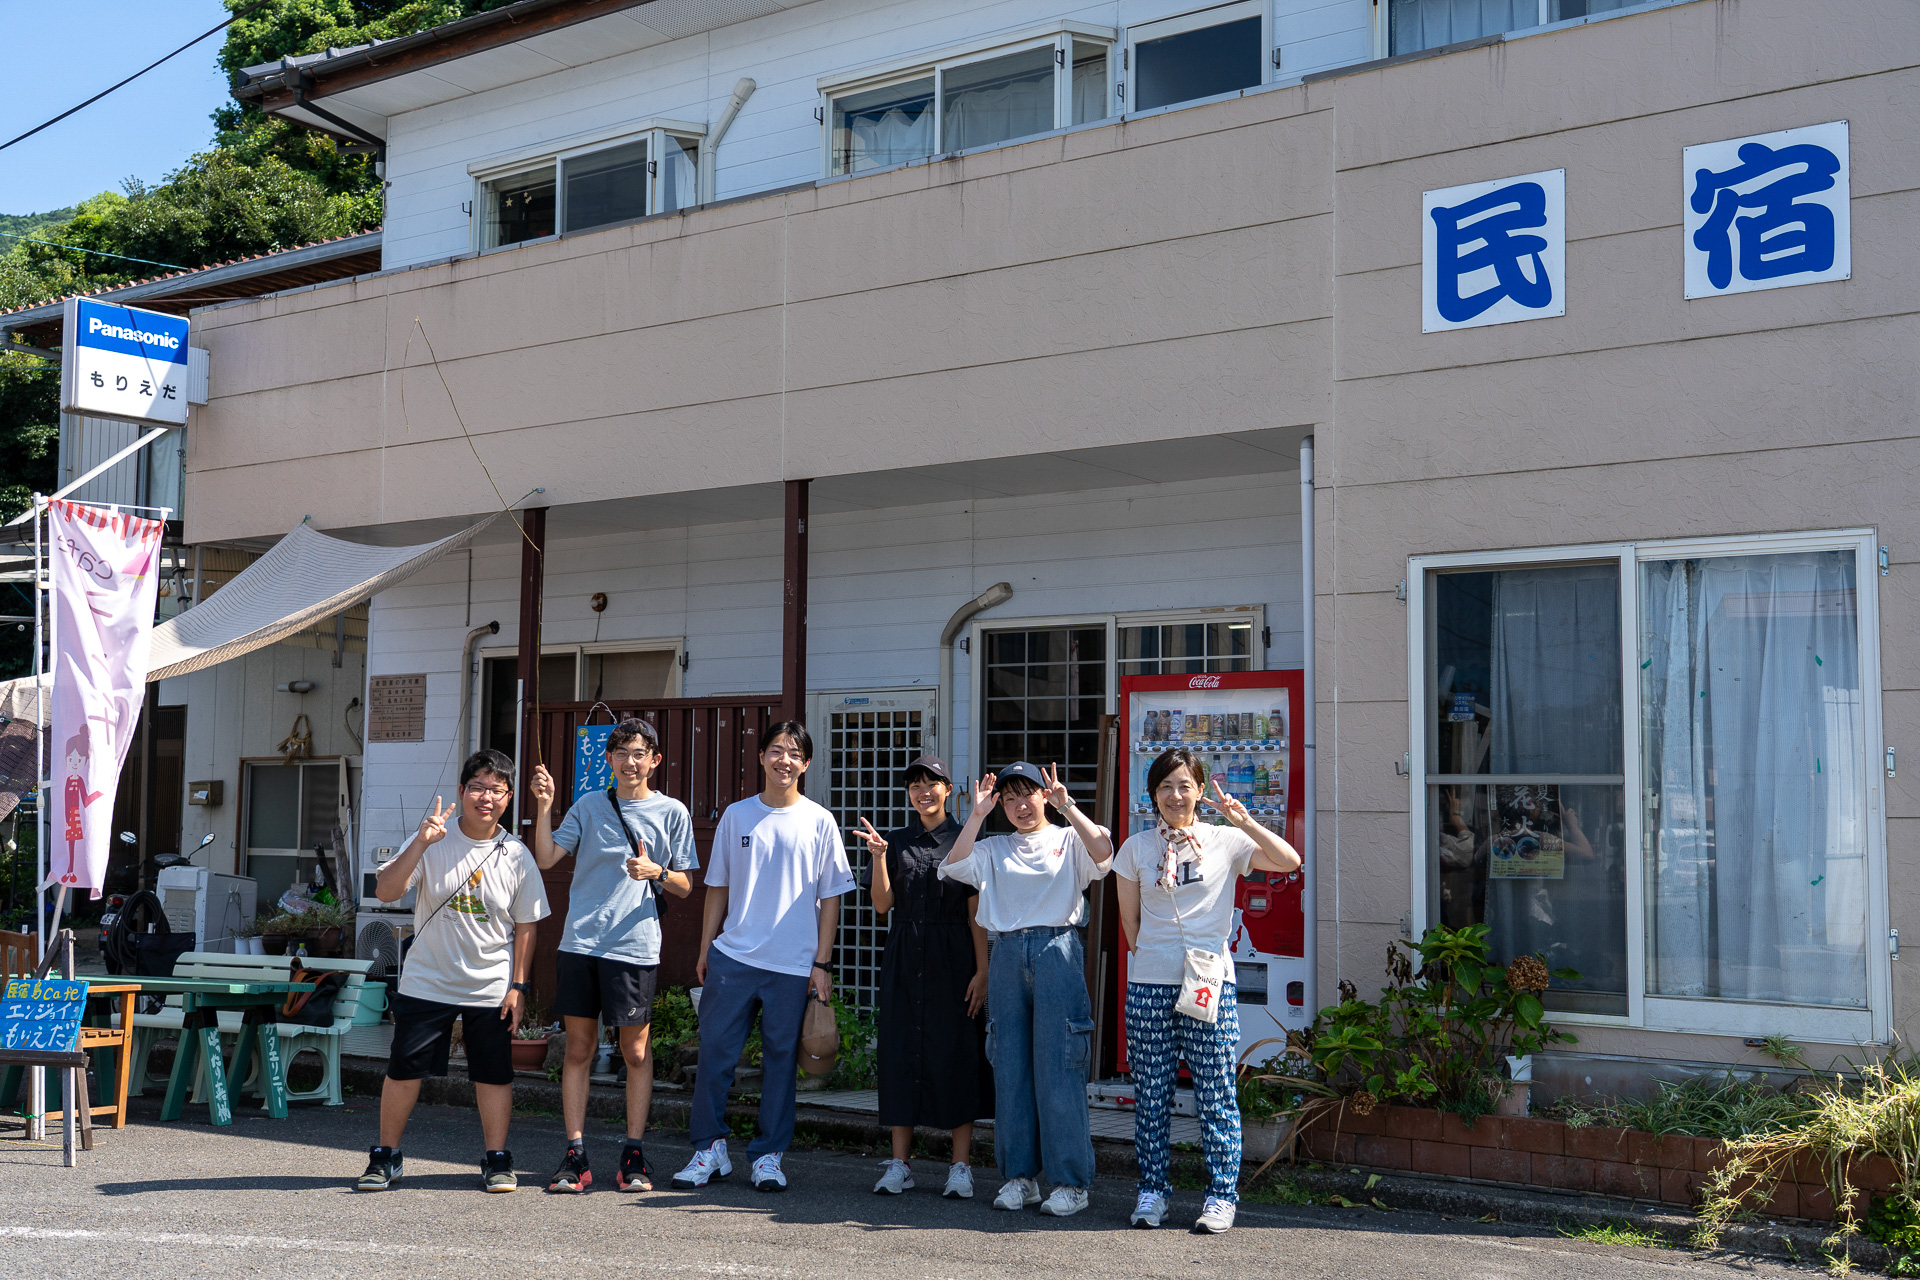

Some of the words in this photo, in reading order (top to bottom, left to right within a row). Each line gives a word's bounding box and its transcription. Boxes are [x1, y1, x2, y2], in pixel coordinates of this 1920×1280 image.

[1430, 182, 1552, 322] 民
[1690, 143, 1841, 289] 宿
[89, 317, 179, 350] Panasonic
[90, 371, 176, 400] もりえだ
[6, 1002, 72, 1020] エンジョイ
[6, 1022, 76, 1049] もりえだ
